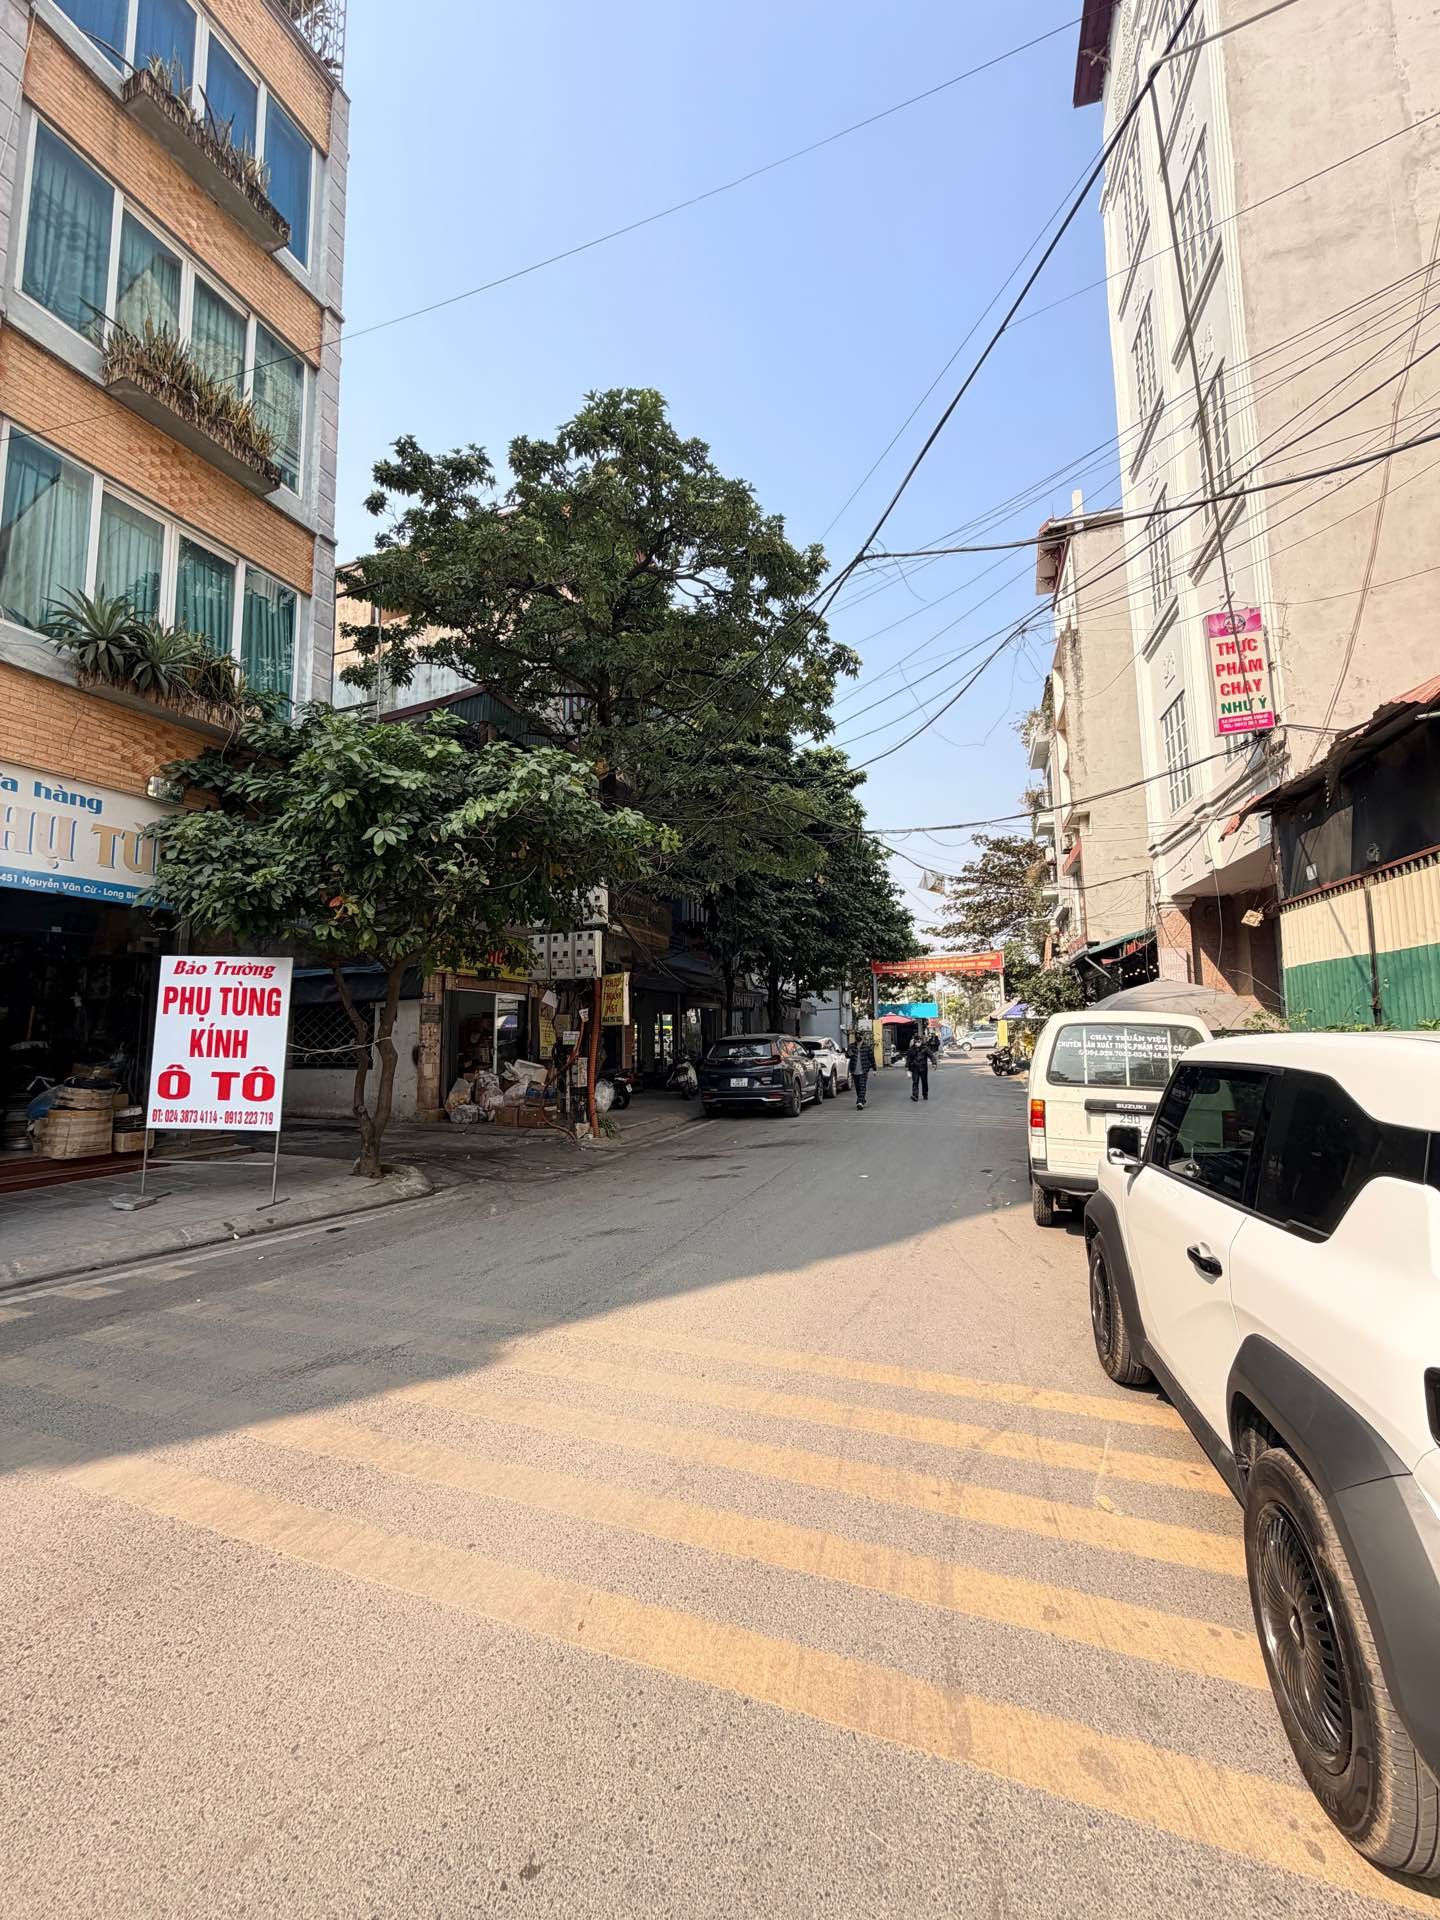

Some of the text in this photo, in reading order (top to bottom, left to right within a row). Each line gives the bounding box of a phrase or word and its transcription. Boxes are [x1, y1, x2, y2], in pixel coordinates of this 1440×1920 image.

[1220, 678, 1262, 696] CHAY
[1221, 695, 1267, 714] NHƯ Ý
[34, 782, 103, 815] hàng
[0, 873, 18, 883] 451
[22, 875, 60, 890] Nguyễn
[62, 881, 81, 892] Văn
[83, 884, 97, 895] Cừ
[104, 887, 124, 899] Long
[173, 960, 276, 979] Bảo Trường
[162, 981, 282, 1022] PHỤ TÙNG
[189, 1022, 249, 1059] KÍNH
[157, 1063, 276, 1102] Ô TÔ
[152, 1108, 163, 1122] ĐT:
[164, 1109, 179, 1123] 024
[180, 1110, 198, 1123] 3873
[200, 1110, 218, 1124] 4114
[224, 1111, 243, 1125] 0913
[244, 1112, 258, 1125] 223
[260, 1111, 274, 1125] 719
